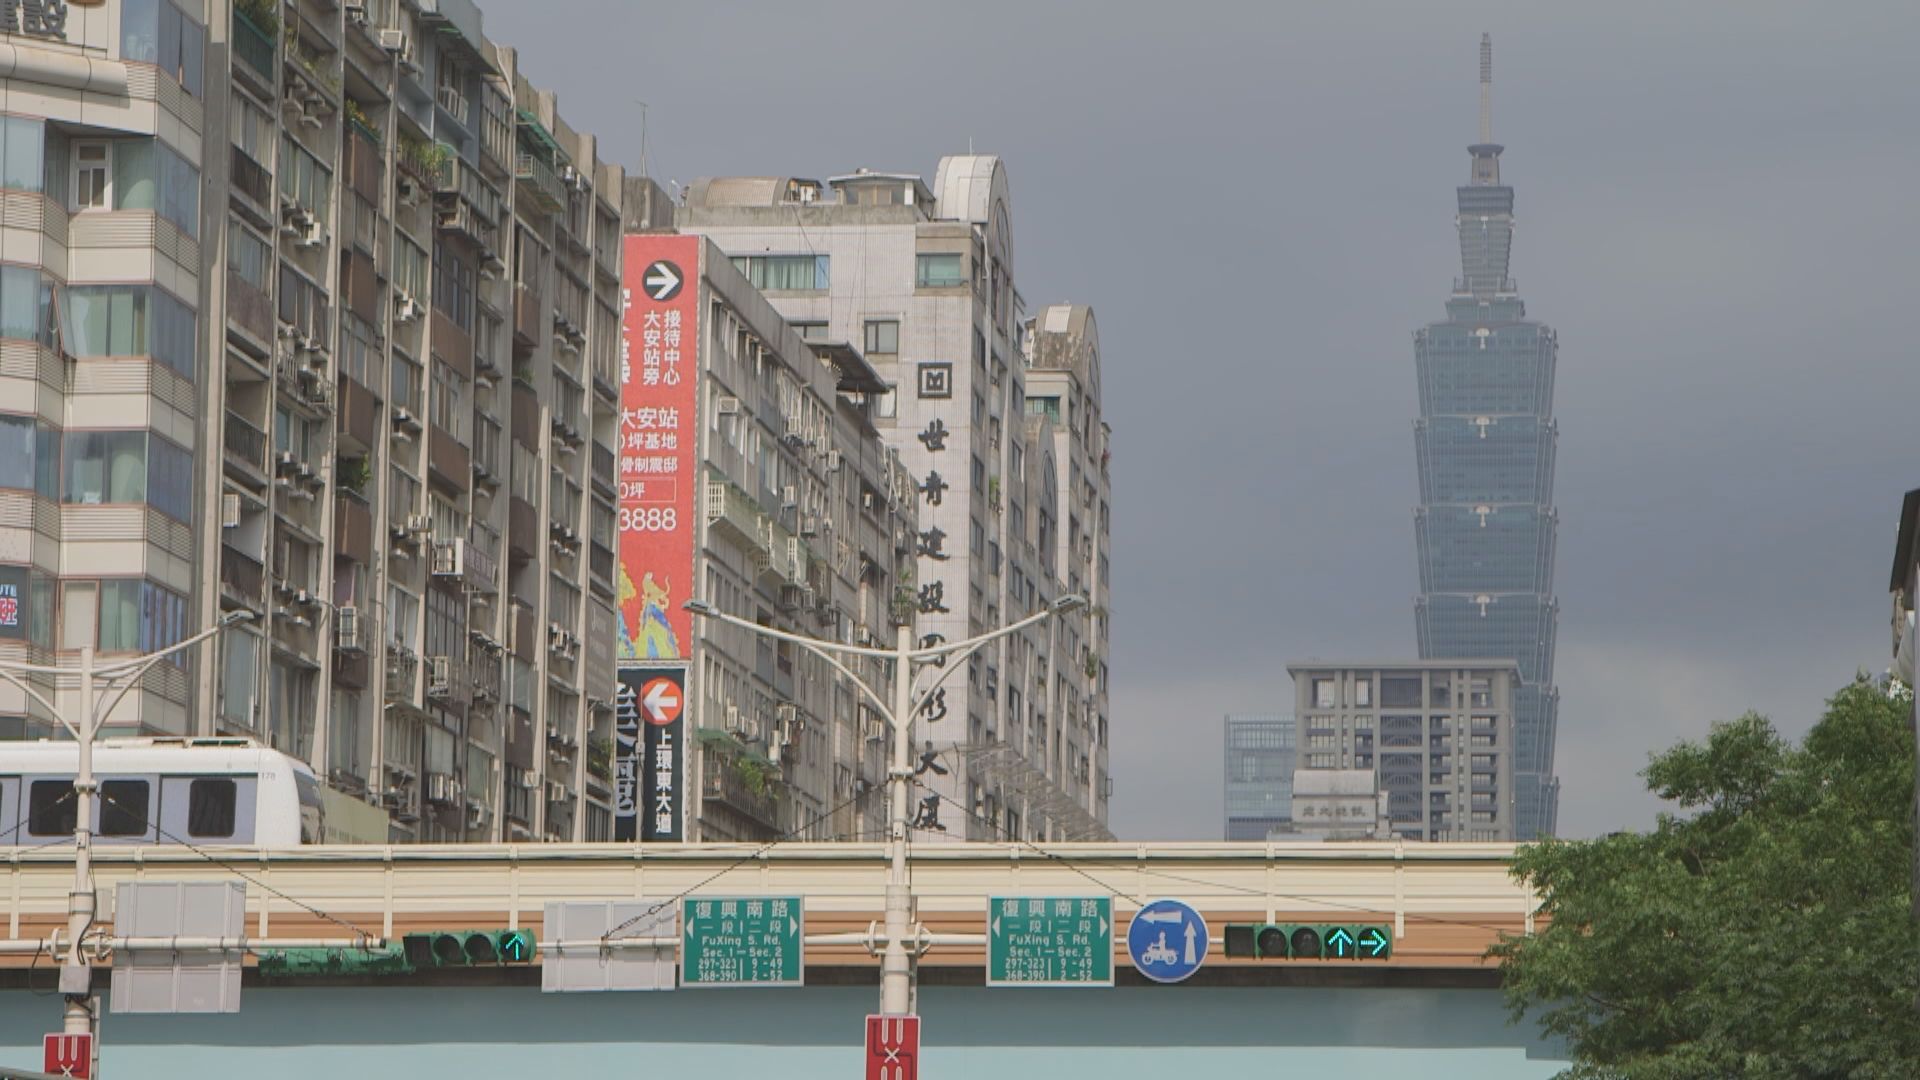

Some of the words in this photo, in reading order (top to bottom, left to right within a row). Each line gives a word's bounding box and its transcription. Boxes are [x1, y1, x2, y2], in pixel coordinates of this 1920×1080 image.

[643, 309, 661, 385] 大安站旁
[663, 309, 681, 385] 接待中心
[620, 406, 678, 429] 大安站
[655, 727, 673, 834] 上環東大道
[696, 900, 788, 919] 復興南路
[1002, 900, 1098, 917] 復興南路
[701, 919, 734, 934] 一段
[749, 919, 782, 933] 二段
[1007, 919, 1042, 933] 一段
[1057, 919, 1091, 933] 二段
[764, 934, 781, 945] Rd.
[1072, 934, 1091, 945] Rd.
[703, 947, 725, 957] Sec.
[749, 947, 771, 957] Sec.
[774, 946, 783, 957] 2
[1009, 946, 1033, 957] Sec.
[1057, 946, 1081, 957] Sec.
[1084, 946, 1092, 957] 2
[698, 958, 737, 969] 297-323
[1005, 958, 1045, 969] 297-323
